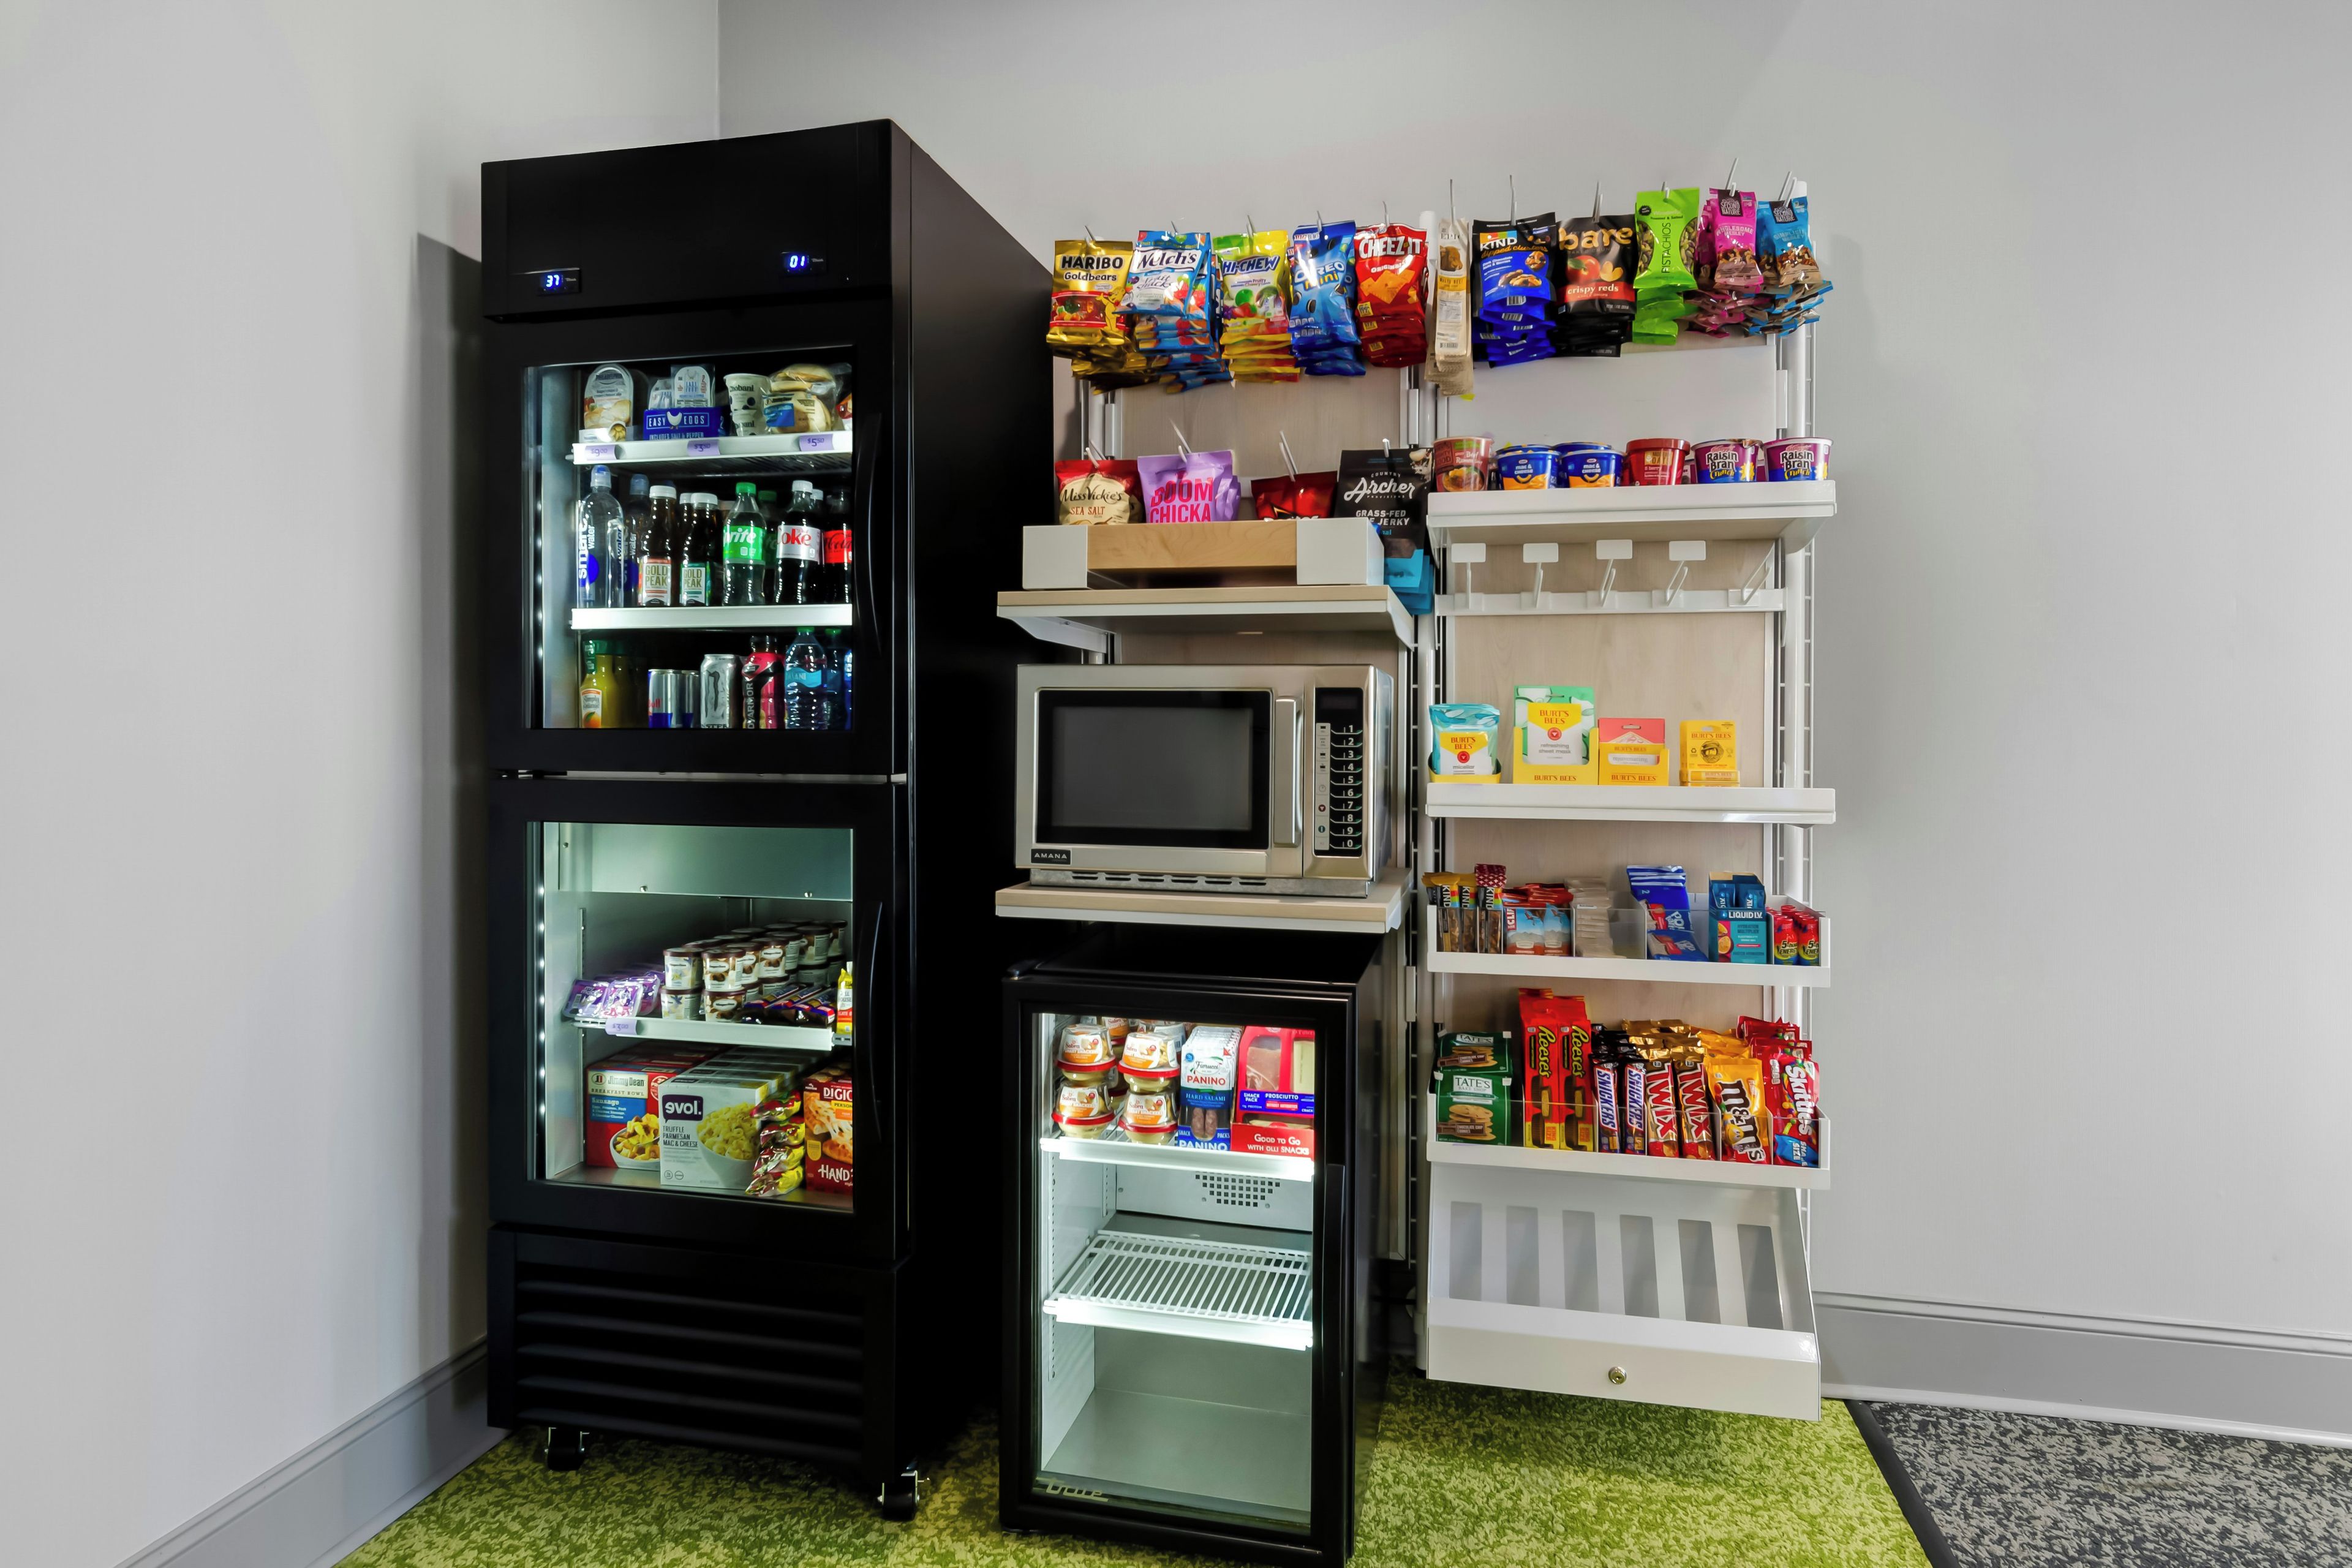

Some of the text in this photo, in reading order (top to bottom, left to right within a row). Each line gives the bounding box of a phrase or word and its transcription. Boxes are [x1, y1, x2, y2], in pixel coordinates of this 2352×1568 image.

[1721, 200, 1740, 209] SECOND
[1773, 207, 1793, 217] SECOND
[1716, 225, 1754, 236] WHOLESOME
[1480, 237, 1518, 252] KIND
[1558, 227, 1633, 250] bare
[1481, 245, 1512, 258] dipped
[1661, 222, 1672, 273] PISTACHIOS
[790, 255, 805, 268] 01
[1061, 255, 1123, 270] HARIBO
[1137, 252, 1197, 269] Welch's
[1223, 255, 1281, 276] HI-CHEW
[546, 274, 560, 287] 37
[1064, 272, 1117, 281] Goldbears
[1567, 285, 1596, 294] crispy
[649, 415, 704, 427] EASY EGGS
[1706, 451, 1738, 463] Raisin
[1781, 451, 1813, 463] Raisin
[1711, 459, 1735, 471] Bran
[1785, 459, 1811, 471] Bran
[1709, 469, 1735, 480] Crunch
[1784, 469, 1810, 480] Crunch
[1060, 484, 1123, 505] Miss Vickie's
[1150, 477, 1213, 507] BOOM
[1344, 477, 1415, 503] Archer
[1071, 507, 1106, 515] SEA SALT
[1150, 503, 1212, 524] CHICKA
[723, 528, 757, 544] prite
[646, 565, 668, 576] GOLD
[683, 568, 702, 579] GOLD
[646, 576, 668, 586] PEAK
[683, 579, 702, 588] PEAK
[746, 682, 755, 729] DYARMOR
[1442, 885, 1451, 908] KIND
[1486, 887, 1494, 911] KIND
[1538, 1025, 1556, 1078] Reese's
[1571, 1025, 1589, 1078] Reese's
[1196, 1061, 1219, 1069] Fiorucci
[608, 1076, 644, 1087] Jimmy Dean
[1186, 1075, 1226, 1085] PANINO
[1455, 1077, 1491, 1088] TATE'S
[823, 1087, 853, 1101] DIGI
[1596, 1070, 1616, 1129] SNICKERS
[1628, 1069, 1643, 1129] SNICKERS
[1646, 1062, 1678, 1139] TWIX
[1678, 1062, 1711, 1139] TWIX
[1785, 1065, 1815, 1136] Skittles
[592, 1097, 620, 1106] Sausage
[1179, 1139, 1229, 1152] PANINO
[1281, 1146, 1310, 1155] SNACKS
